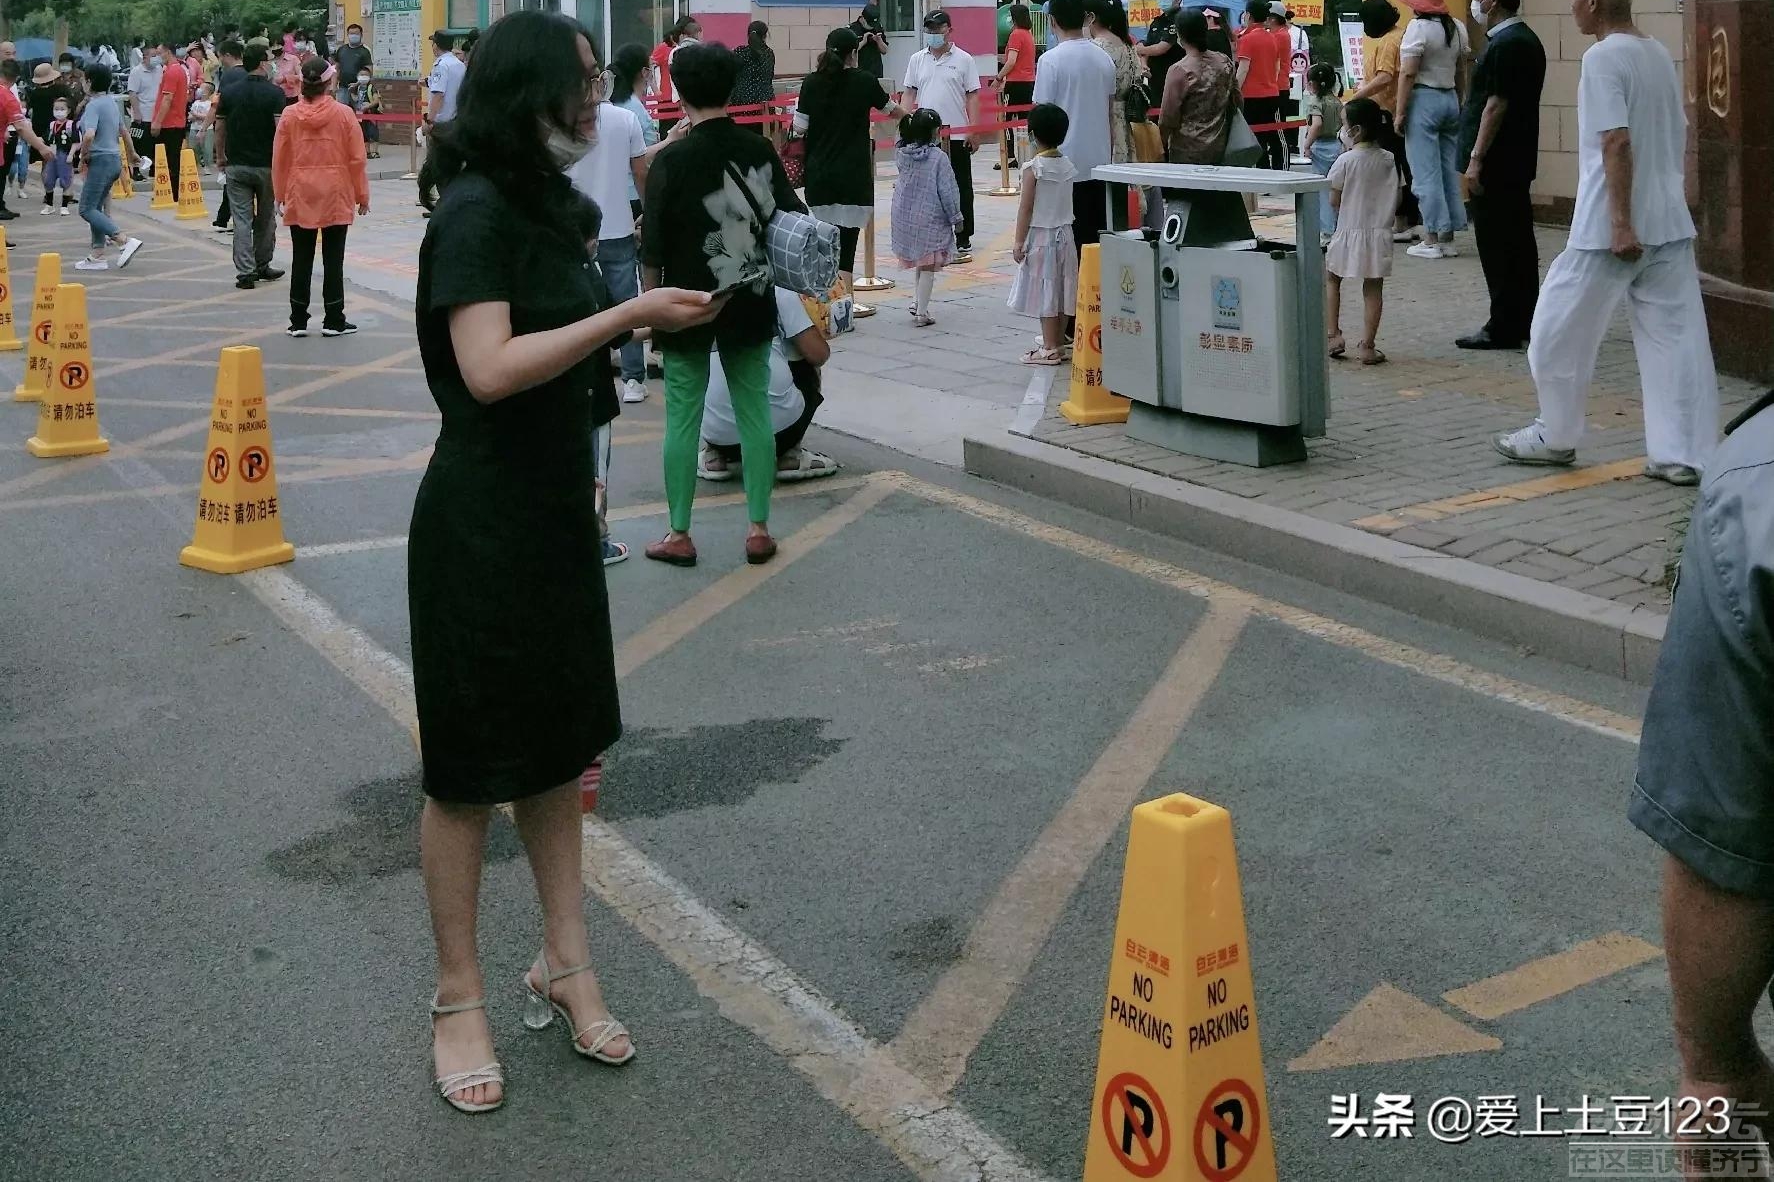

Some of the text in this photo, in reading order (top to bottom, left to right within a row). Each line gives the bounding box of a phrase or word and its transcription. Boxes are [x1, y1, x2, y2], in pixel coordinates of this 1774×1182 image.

[60, 340, 88, 350] PARKING
[53, 402, 95, 421] 请勿泊车
[247, 408, 257, 418] NO
[212, 420, 233, 433] PARKING
[238, 419, 267, 434] PARKING
[200, 498, 231, 523] 请勿泊车
[234, 497, 278, 525] 请勿泊车
[1133, 972, 1153, 1002] NO
[1207, 978, 1227, 1008] NO
[1110, 996, 1172, 1049] PARKING
[1189, 1004, 1249, 1053] PARKING
